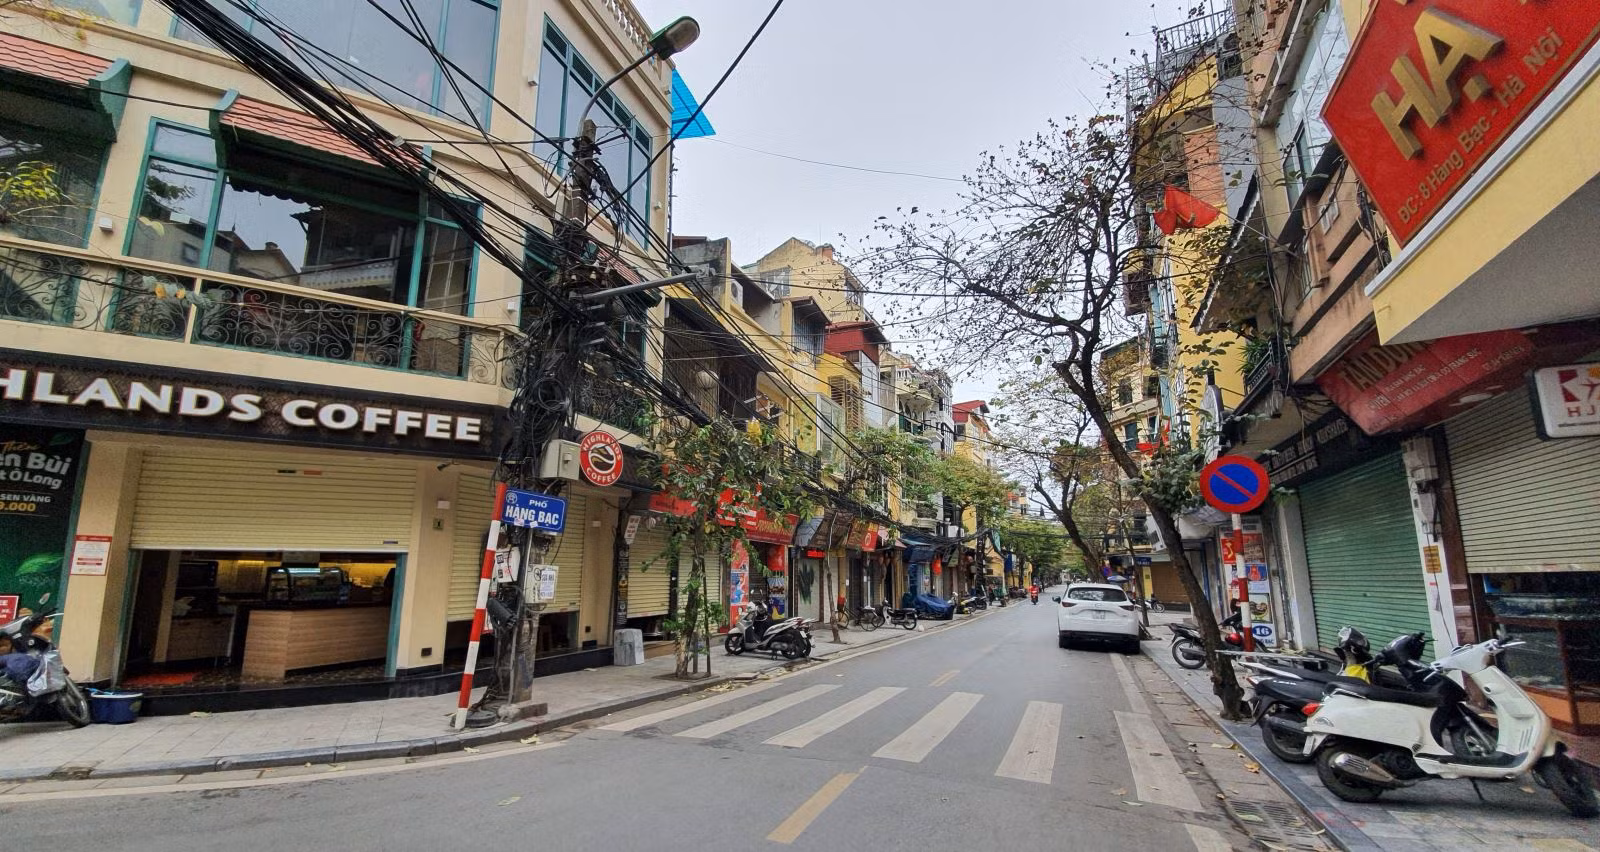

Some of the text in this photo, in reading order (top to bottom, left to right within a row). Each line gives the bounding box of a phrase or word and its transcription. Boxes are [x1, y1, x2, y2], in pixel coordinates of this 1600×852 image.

[1419, 182, 1430, 199] 8
[1426, 149, 1464, 191] Hàng
[1458, 116, 1490, 152] Bạc
[1495, 74, 1526, 109] Hà
[1523, 26, 1563, 75] Nội
[281, 399, 483, 442] COFFEE
[26, 452, 72, 475] Bùi
[23, 471, 63, 490] Long
[586, 467, 617, 483] COFFEE
[23, 494, 51, 503] VÀNG
[529, 499, 549, 509] PHỐ
[505, 503, 560, 527] HÀNG BẠC
[1255, 627, 1270, 636] 16
